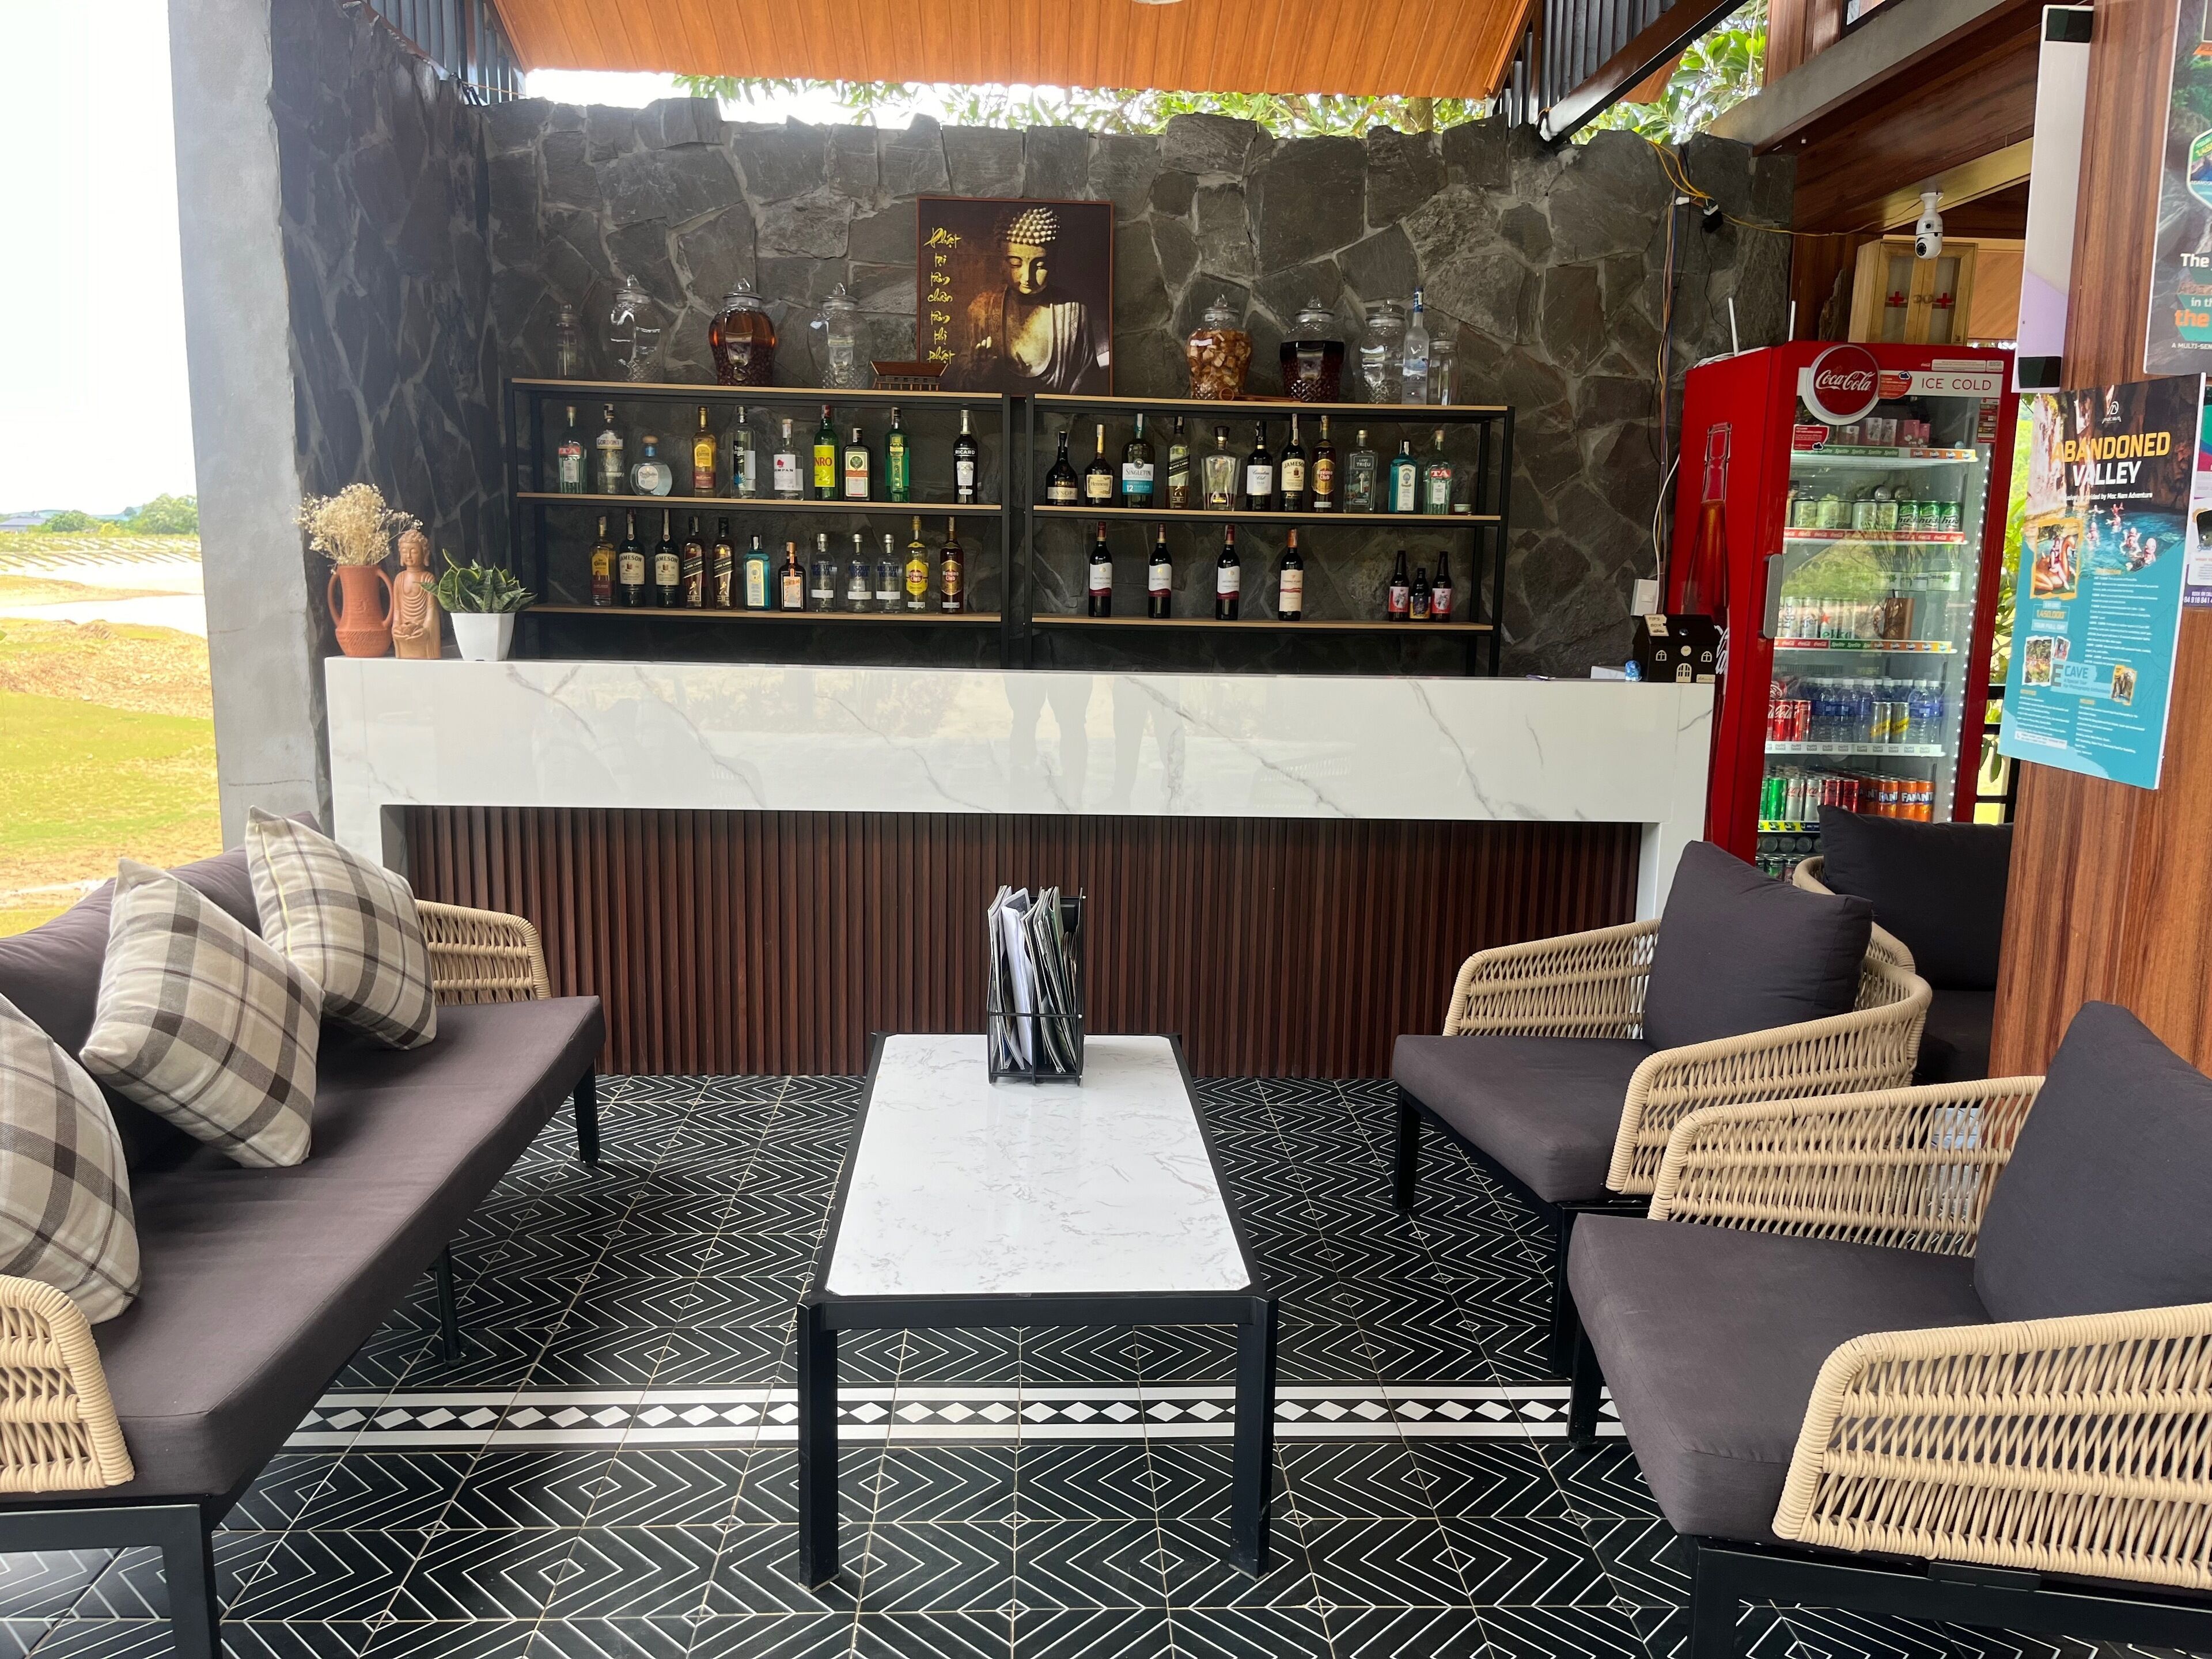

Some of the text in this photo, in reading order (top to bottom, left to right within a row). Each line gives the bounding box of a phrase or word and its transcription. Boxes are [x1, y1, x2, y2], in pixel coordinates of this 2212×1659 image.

[2180, 253, 2210, 267] The
[2191, 297, 2201, 306] in
[2175, 309, 2210, 327] the
[1922, 378, 1991, 391] ICE COLD
[2051, 431, 2171, 462] ABANDONED
[2073, 461, 2142, 486] VALLEY
[2065, 665, 2089, 679] CAVE
